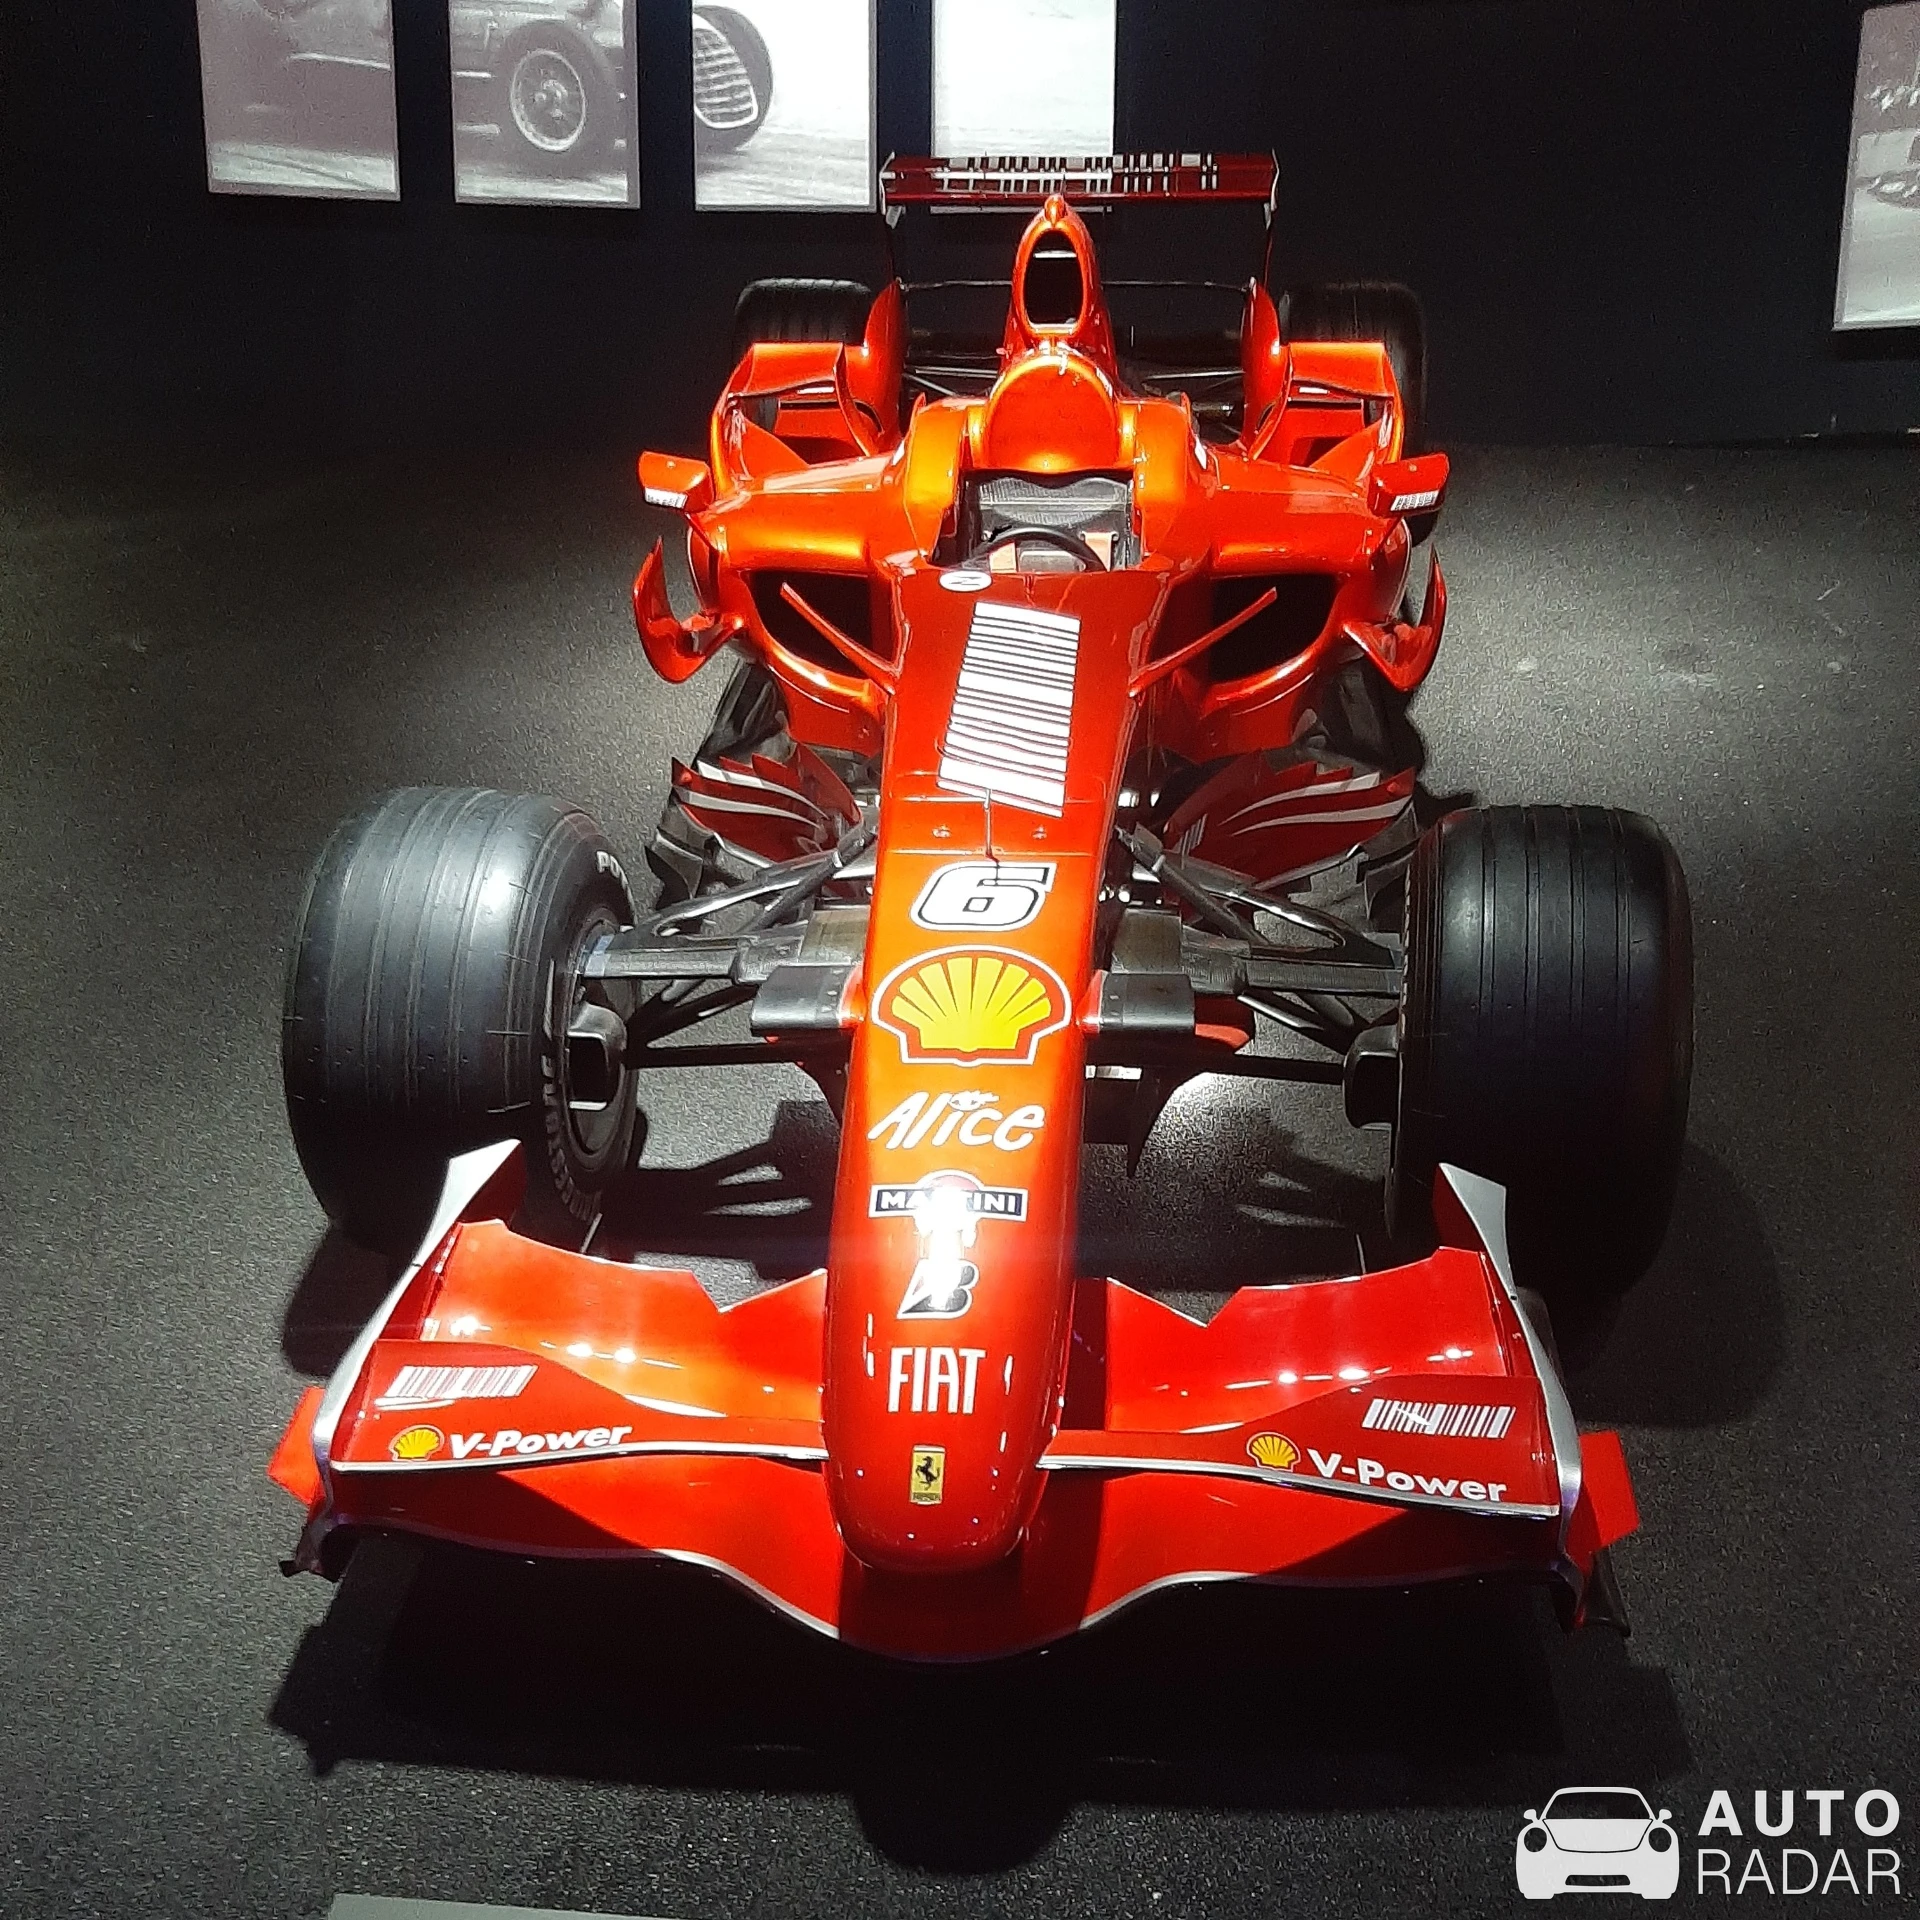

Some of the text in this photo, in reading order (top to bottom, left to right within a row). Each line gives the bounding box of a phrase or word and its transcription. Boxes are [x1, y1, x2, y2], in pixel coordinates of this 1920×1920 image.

[910, 861, 1057, 932] 6
[867, 1090, 1046, 1151] Alice
[880, 1190, 1017, 1213] MAINI
[888, 1346, 987, 1415] FIAT
[450, 1426, 633, 1460] V-Power
[1307, 1448, 1507, 1502] V-Power
